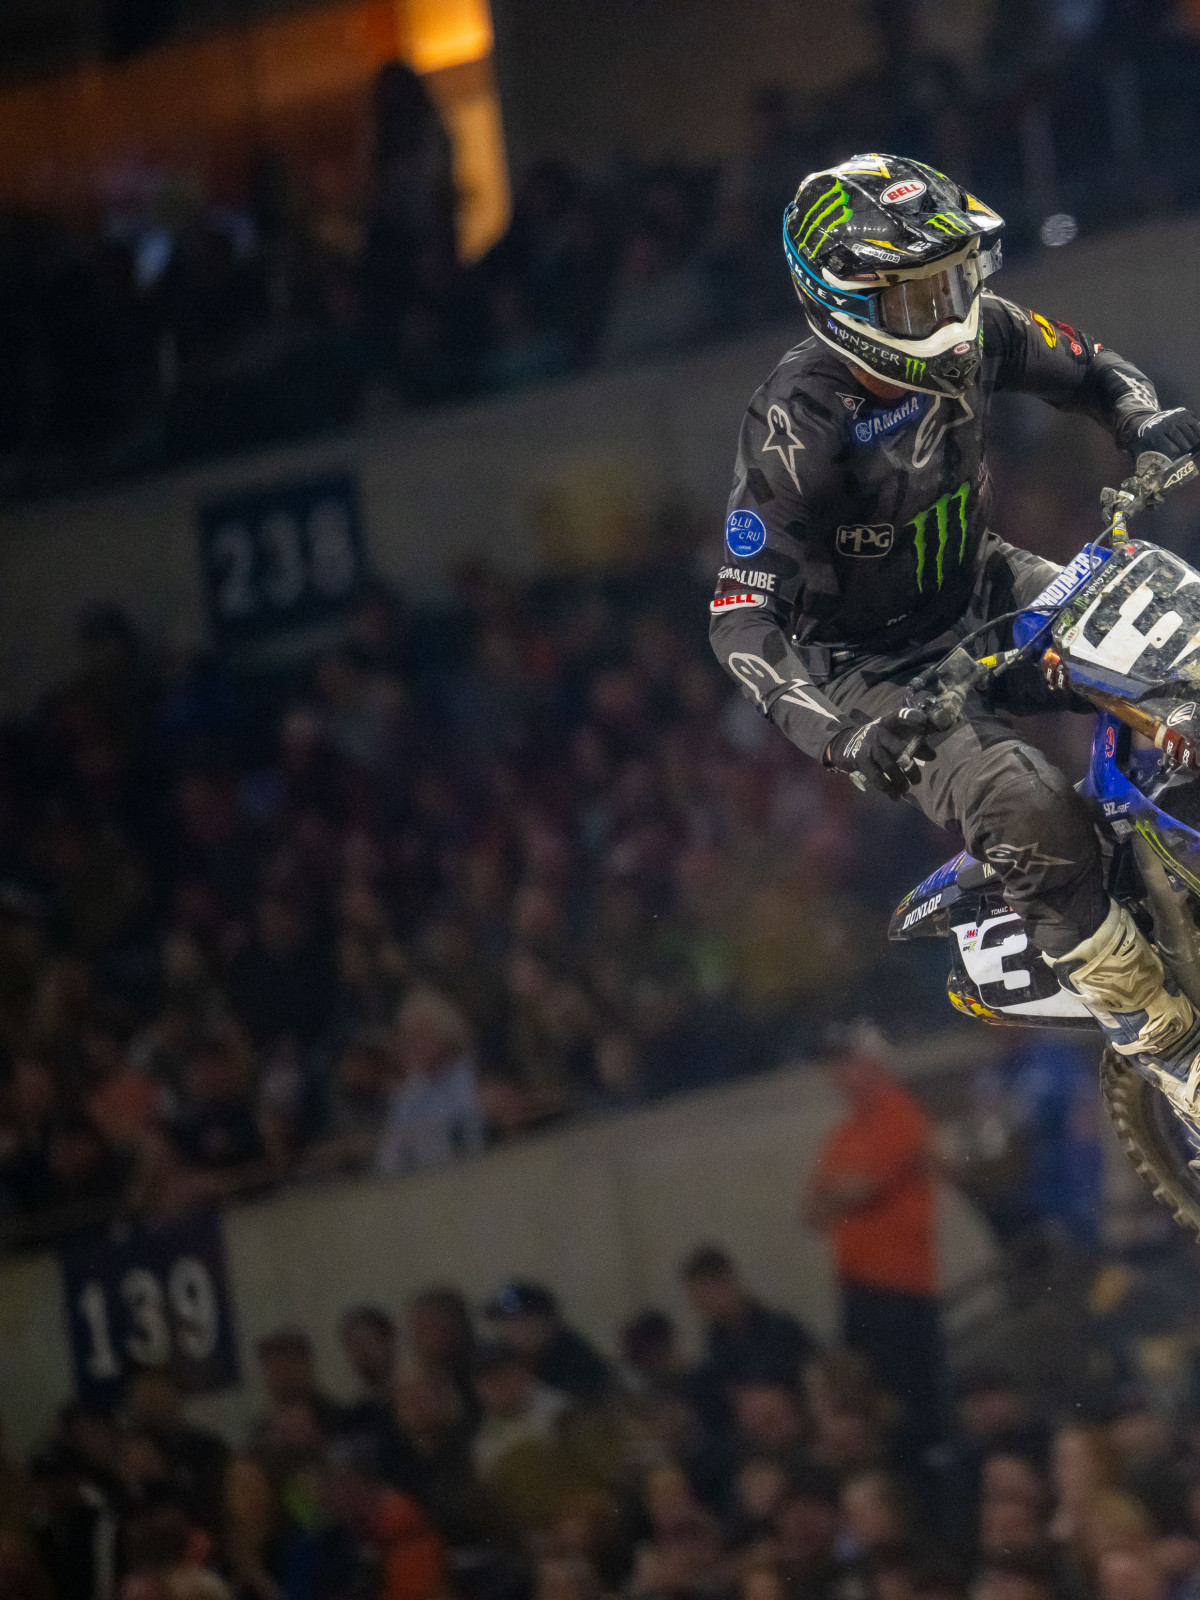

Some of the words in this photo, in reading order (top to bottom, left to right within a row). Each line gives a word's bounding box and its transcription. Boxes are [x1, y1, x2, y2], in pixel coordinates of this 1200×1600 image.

[886, 183, 921, 201] BELL
[826, 318, 900, 366] MONSTER
[868, 396, 919, 435] YAMAHA
[1163, 460, 1195, 489] ARC
[840, 526, 890, 553] PPG
[1030, 552, 1095, 609] PROTAPER
[1082, 563, 1118, 598] MONSTER
[712, 594, 756, 608] BELL
[902, 893, 942, 931] DUNLOP
[991, 906, 1009, 916] TOMAC
[963, 928, 979, 940] AMA
[79, 1256, 220, 1378] 139
